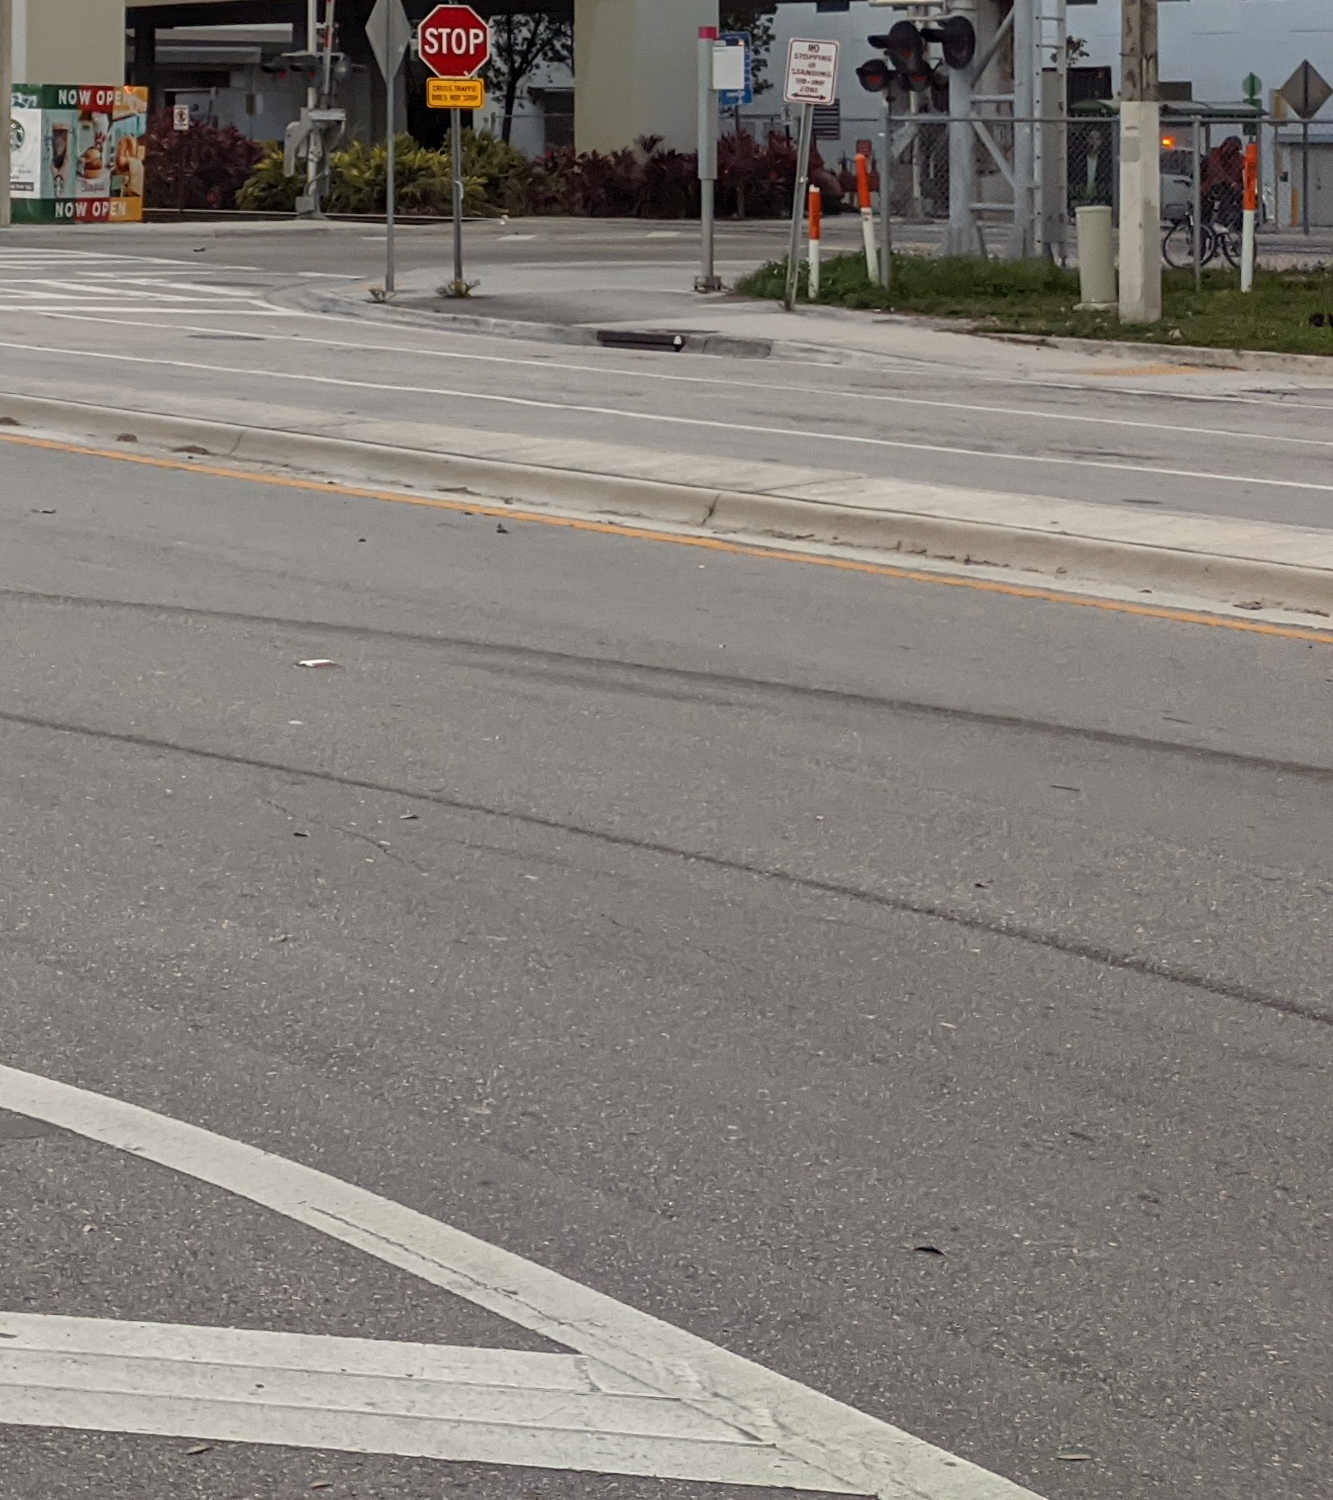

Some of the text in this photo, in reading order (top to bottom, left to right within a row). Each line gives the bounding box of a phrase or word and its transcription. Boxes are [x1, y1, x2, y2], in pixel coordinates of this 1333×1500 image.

[424, 27, 484, 55] STOP
[794, 53, 832, 62] STOPPING
[791, 69, 832, 78] STANDING
[58, 89, 91, 105] NOW
[54, 202, 127, 217] NOW OPEN
